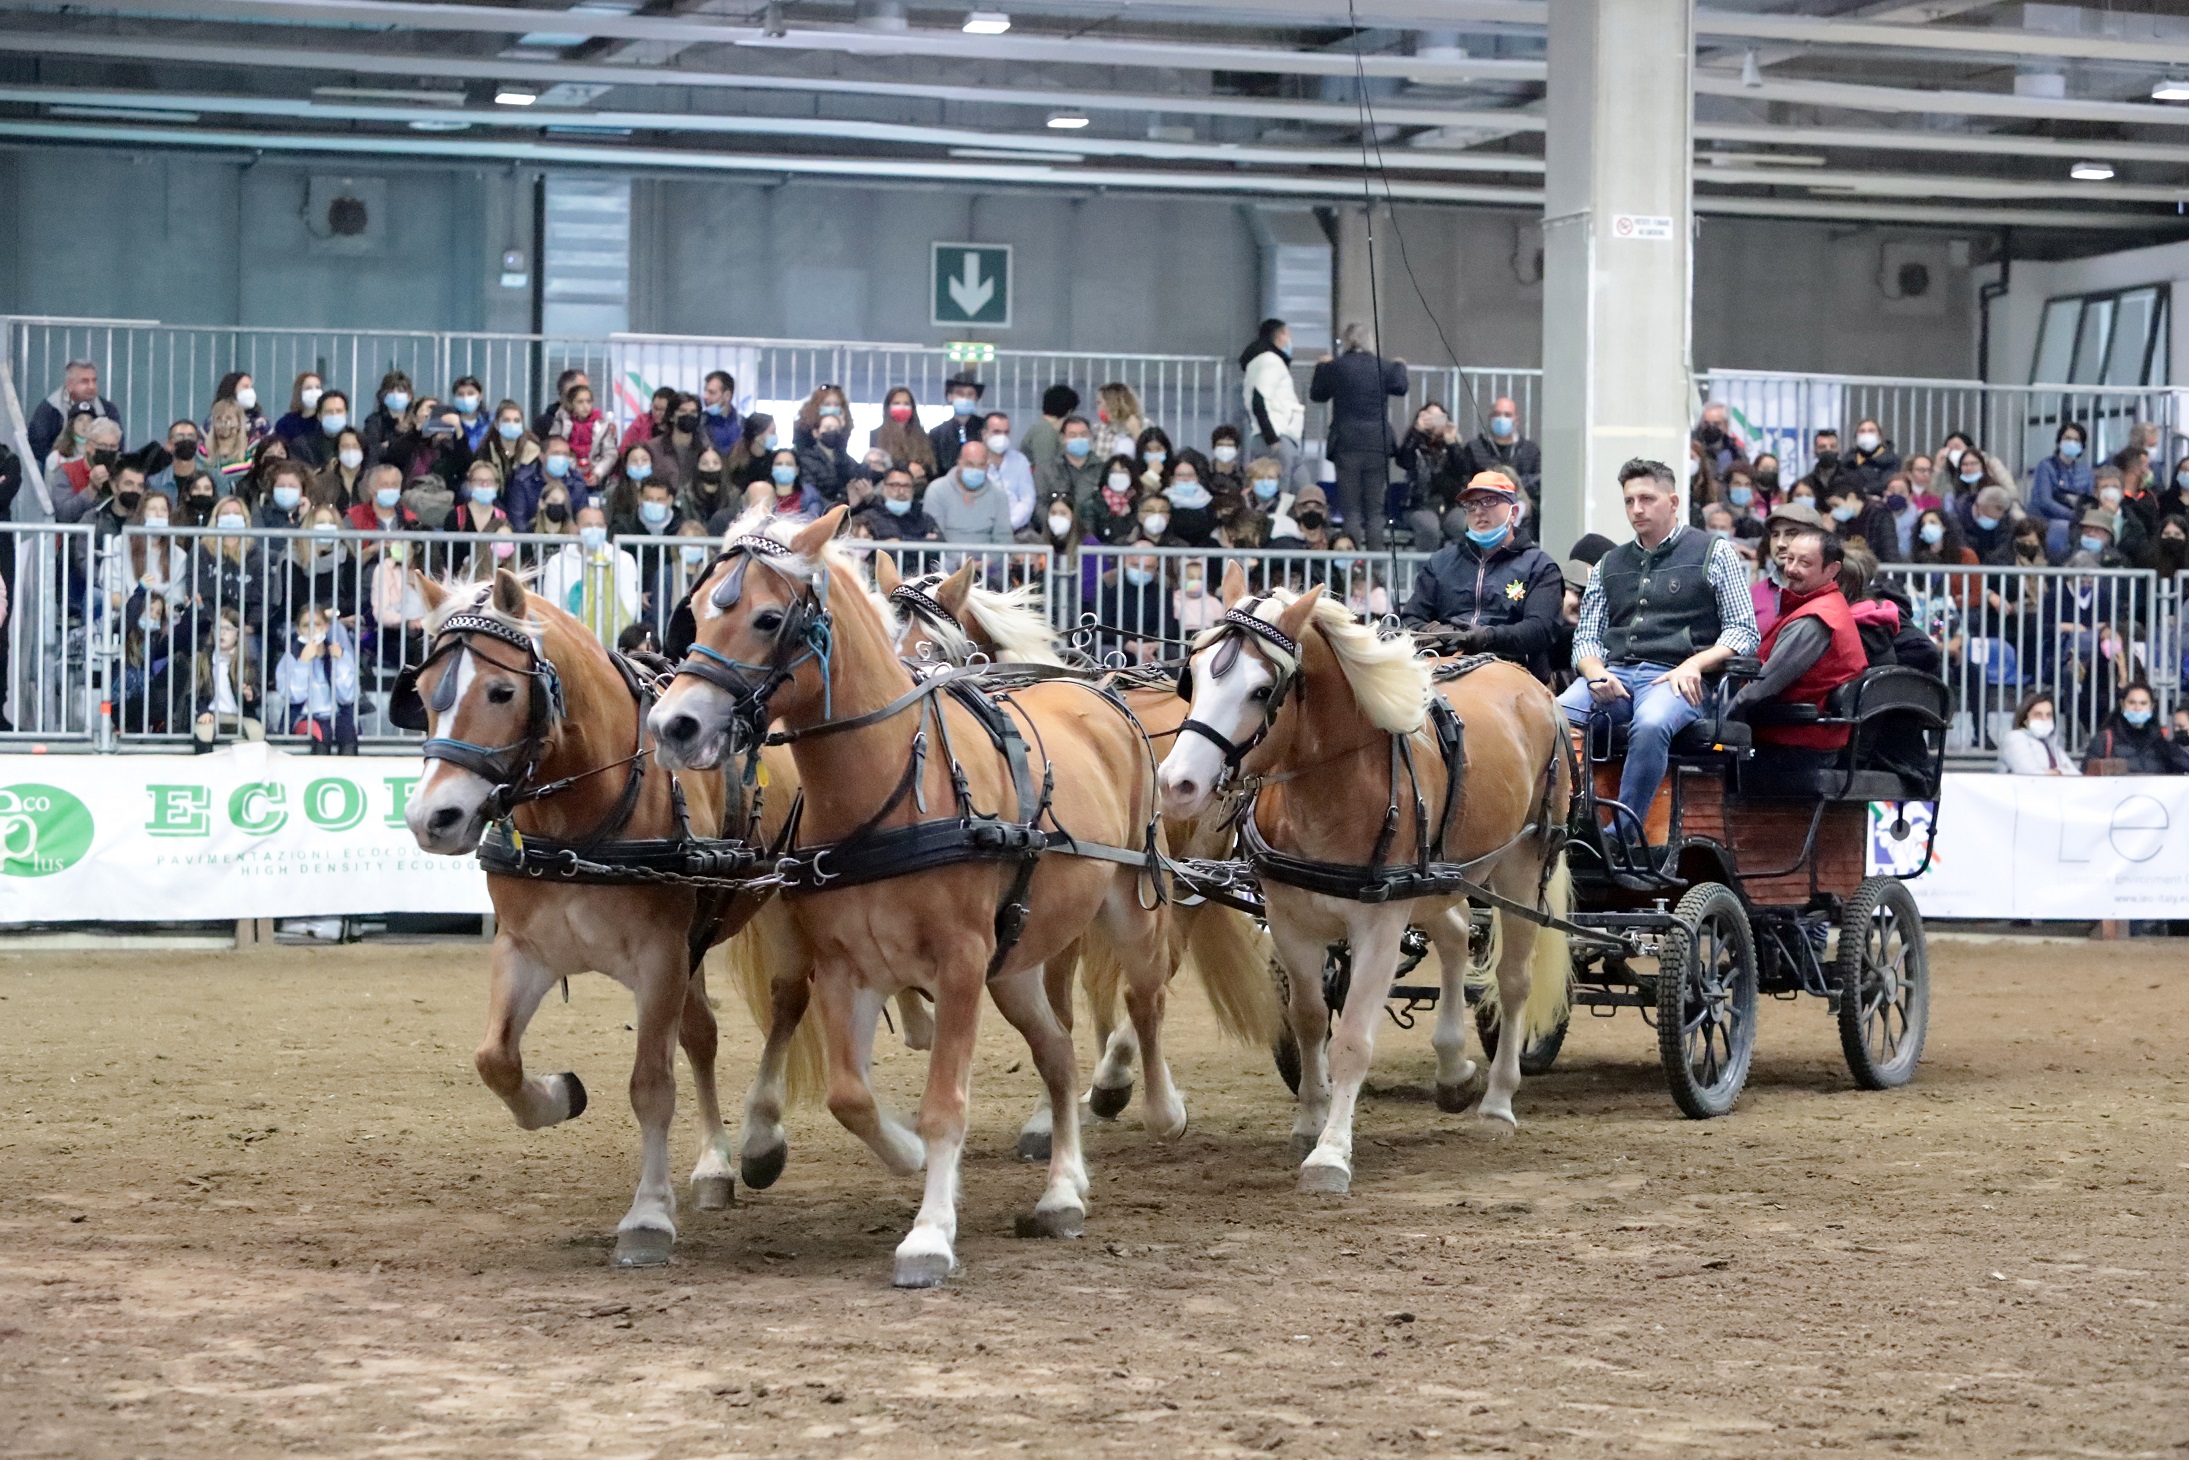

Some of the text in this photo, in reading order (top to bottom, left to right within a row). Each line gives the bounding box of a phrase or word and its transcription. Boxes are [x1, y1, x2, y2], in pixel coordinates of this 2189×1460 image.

[157, 847, 430, 865] PAVIMENTAZIONI ECOLOG
[241, 860, 476, 876] HIGH DENSITY ECOLOG
